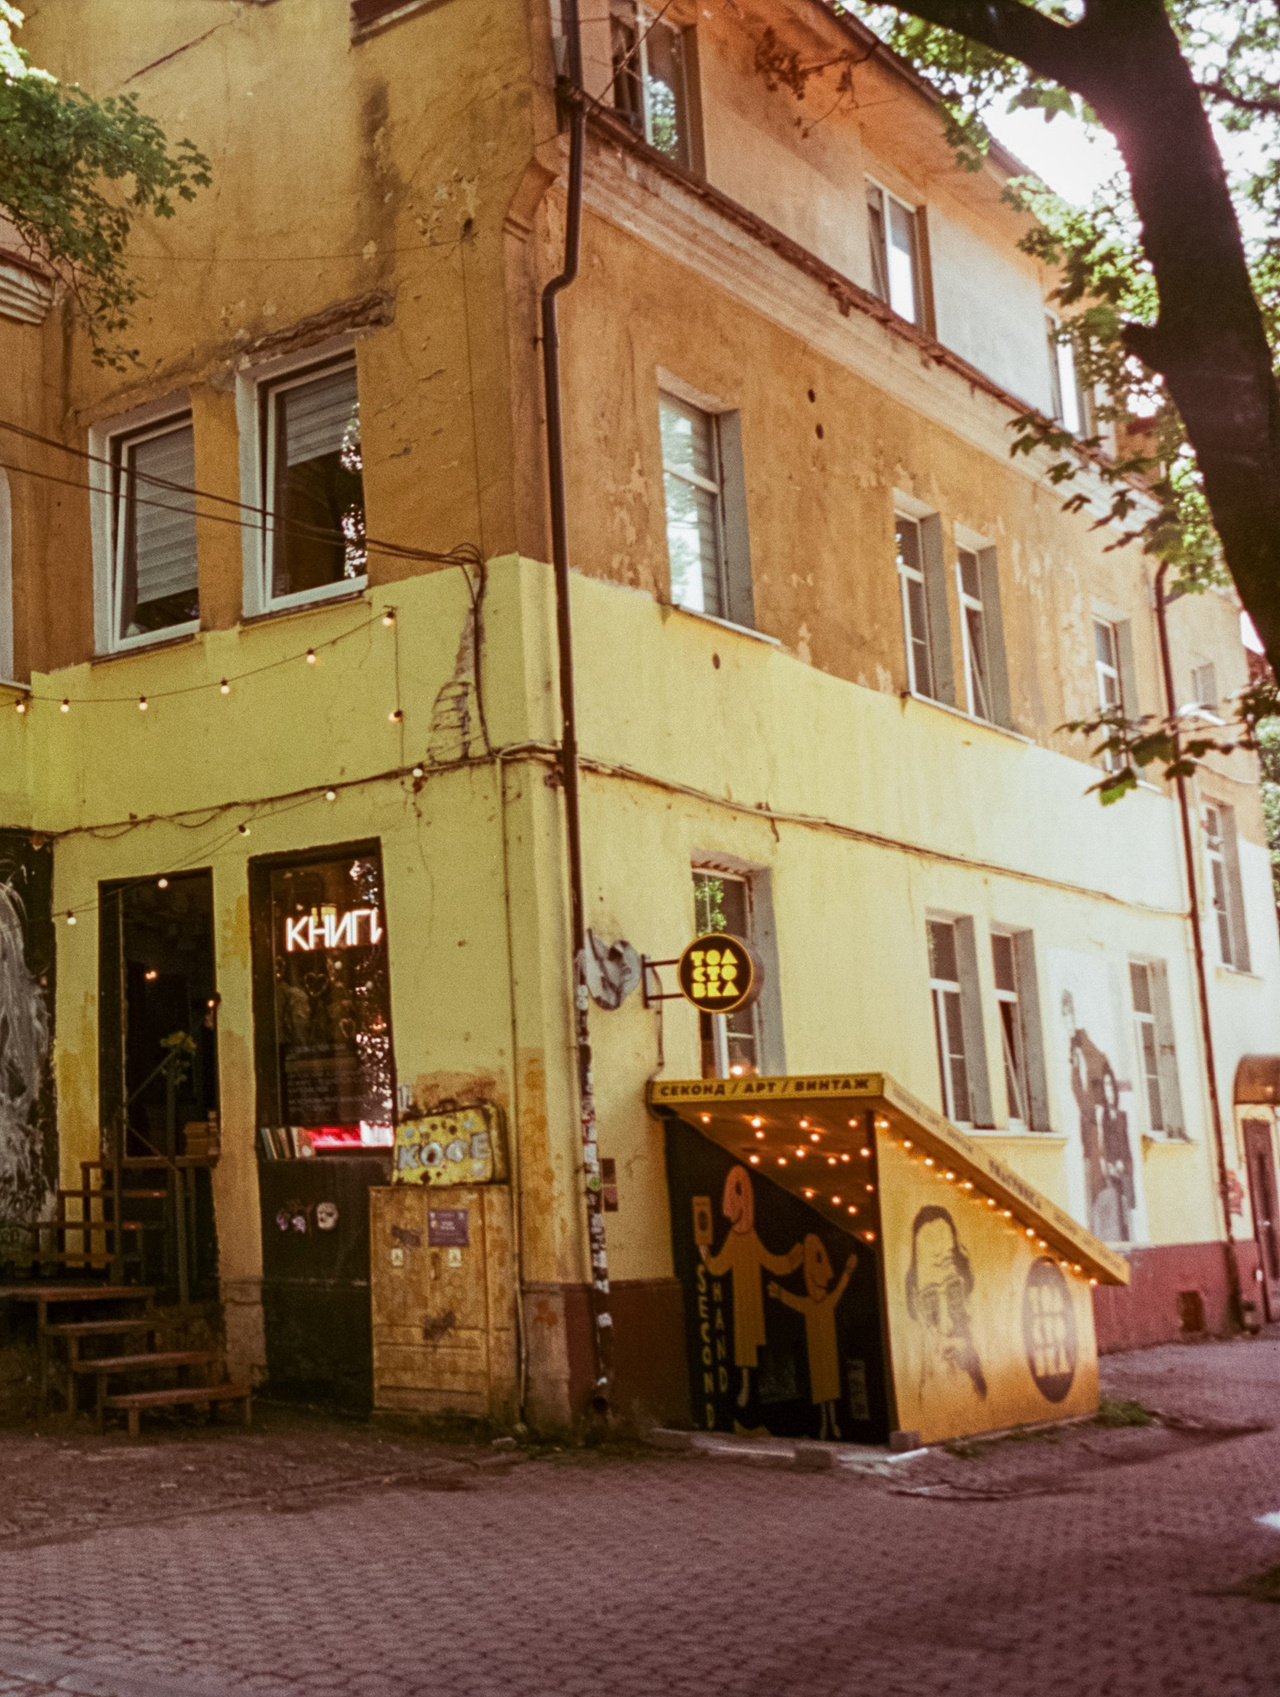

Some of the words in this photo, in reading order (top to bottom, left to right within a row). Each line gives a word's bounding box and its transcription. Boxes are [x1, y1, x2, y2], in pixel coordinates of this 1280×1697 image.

[660, 1083, 726, 1097] СЕКОНД
[744, 1081, 776, 1094] АРТ
[794, 1078, 870, 1092] ВИНТАЖ
[697, 1264, 715, 1429] SECOND
[712, 1281, 728, 1393] HAND
